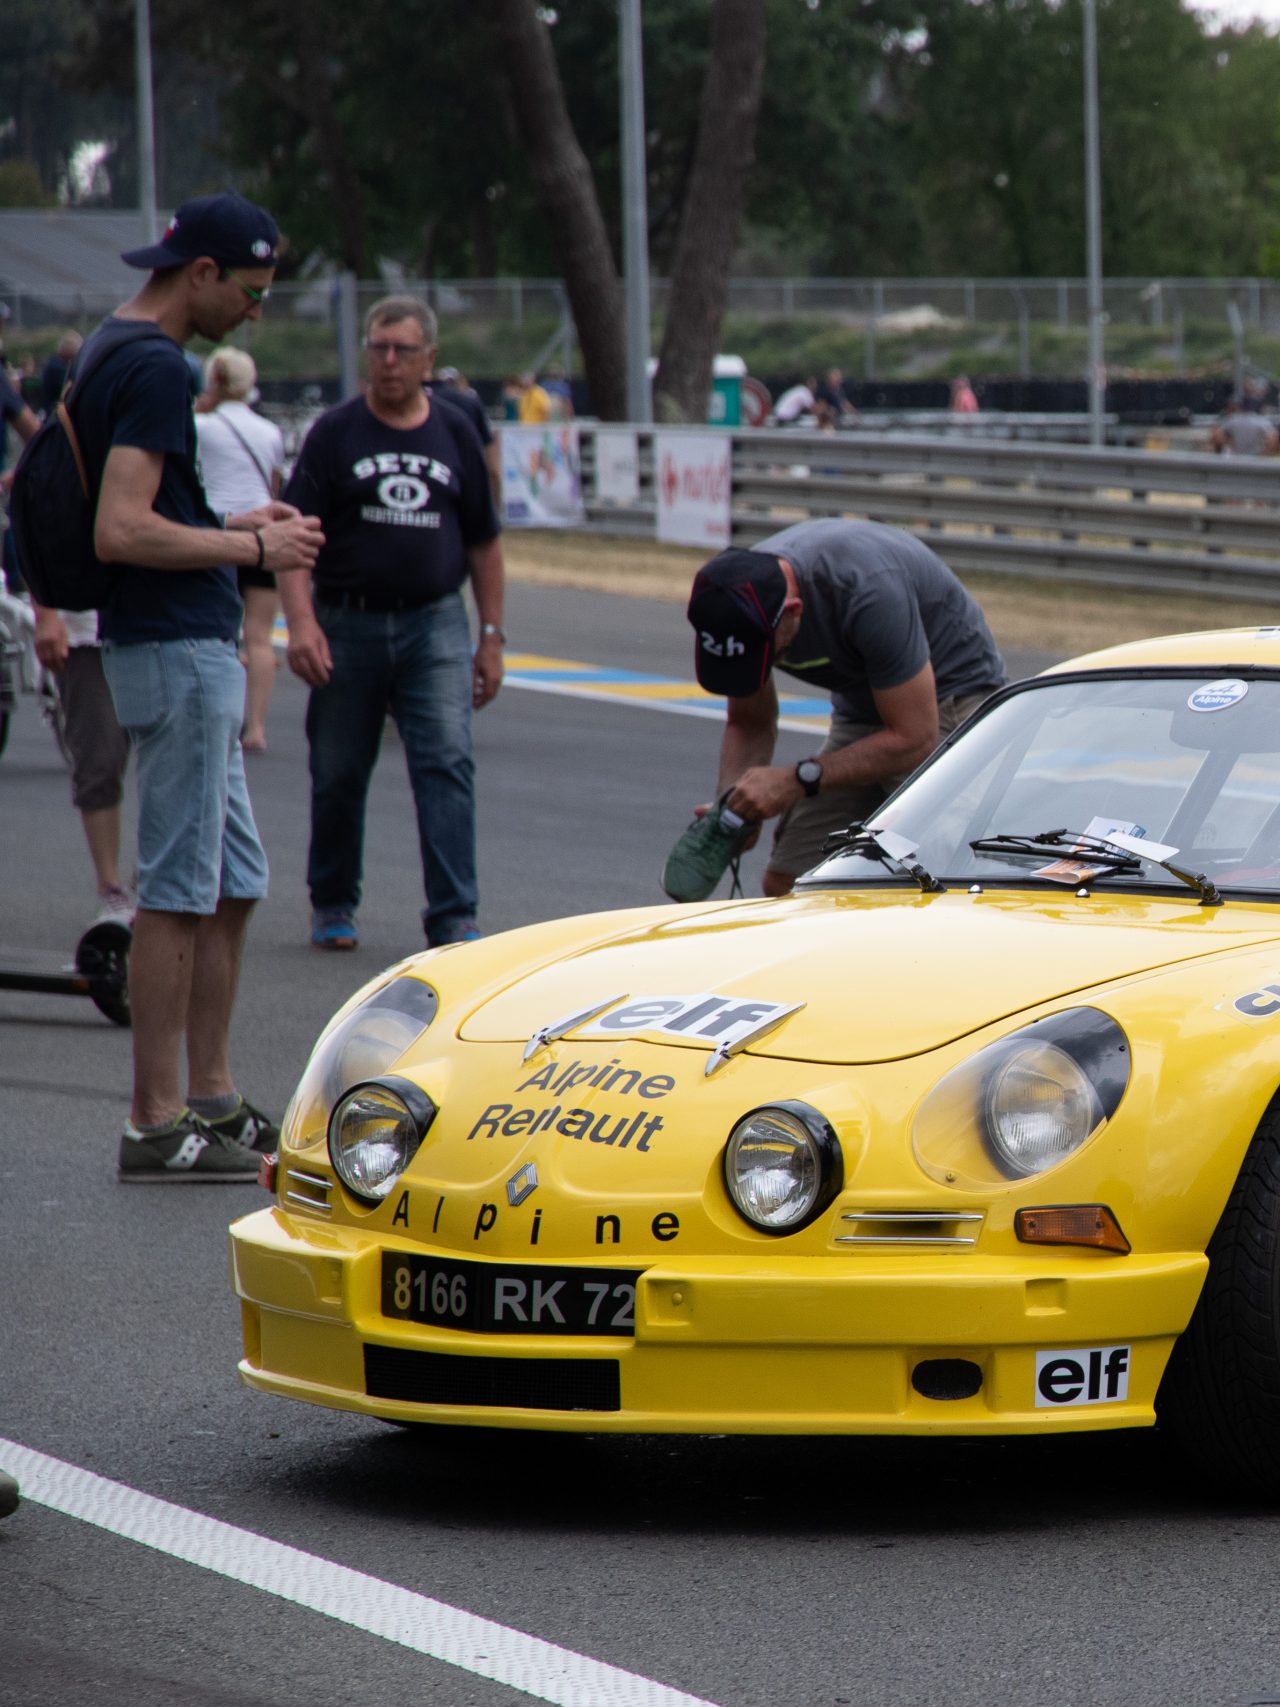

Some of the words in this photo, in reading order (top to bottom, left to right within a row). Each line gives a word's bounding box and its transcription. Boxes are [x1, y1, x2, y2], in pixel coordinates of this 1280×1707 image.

[352, 453, 452, 485] SETE
[1194, 695, 1234, 704] Alpine
[600, 997, 779, 1036] elf
[514, 1059, 676, 1099] Alpine
[467, 1104, 664, 1152] Renault
[391, 1190, 680, 1245] Alpine
[394, 1267, 467, 1318] 8166
[494, 1278, 566, 1325] RK
[583, 1282, 636, 1328] 72
[1038, 1348, 1128, 1403] elf
